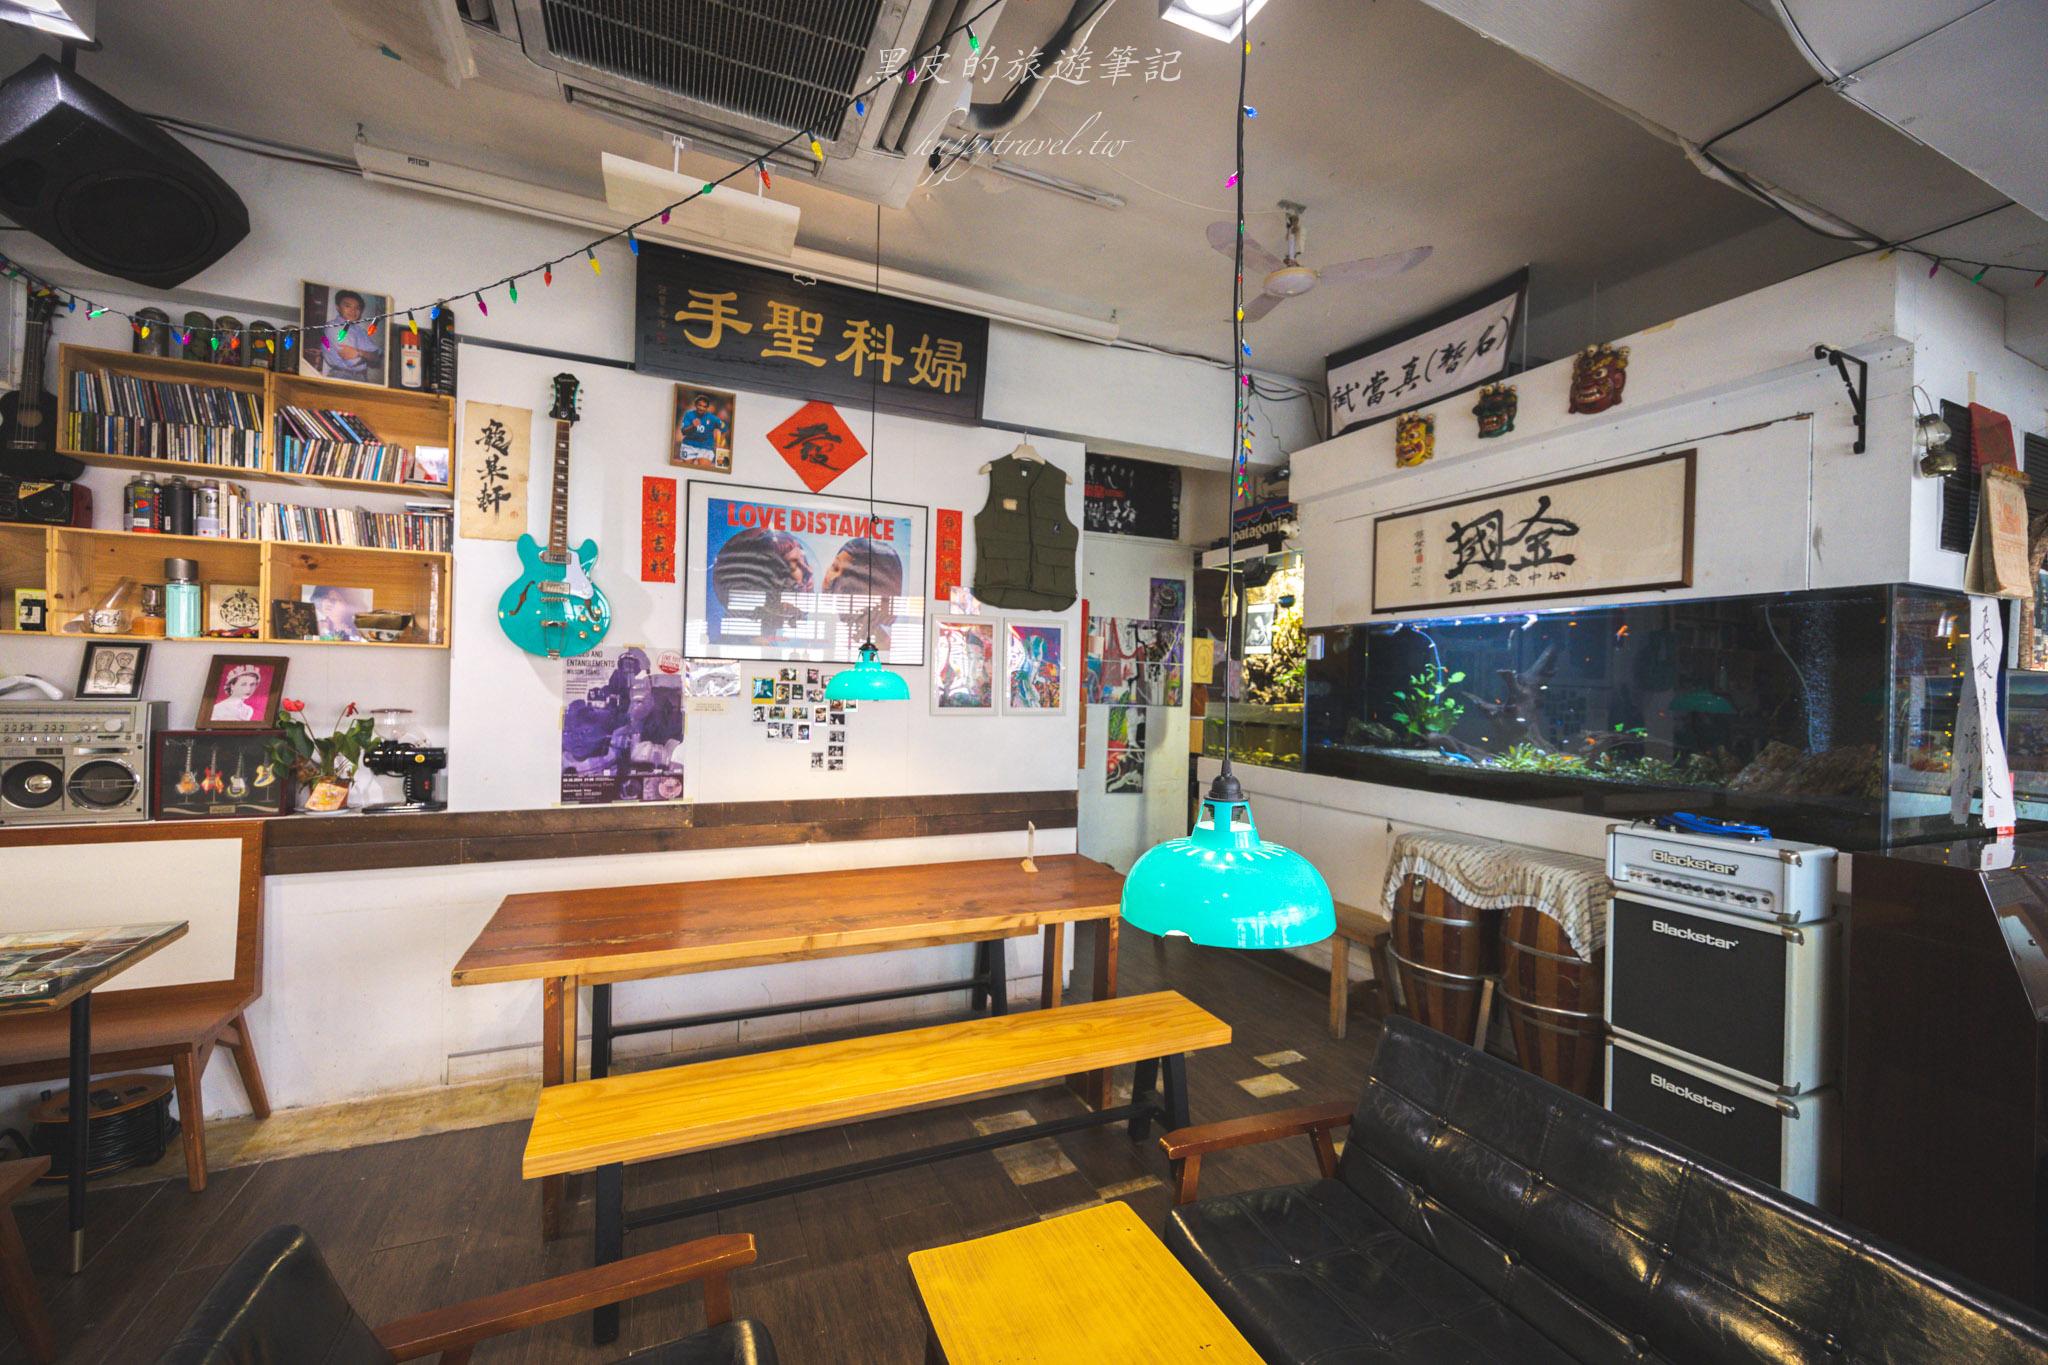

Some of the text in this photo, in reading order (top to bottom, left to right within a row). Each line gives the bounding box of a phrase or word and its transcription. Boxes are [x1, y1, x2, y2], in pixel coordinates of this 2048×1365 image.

[727, 502, 786, 531] LOVE
[1652, 849, 1735, 875] Blackstar
[1652, 920, 1736, 949] Blackstar
[1650, 1073, 1733, 1114] Blackstar
